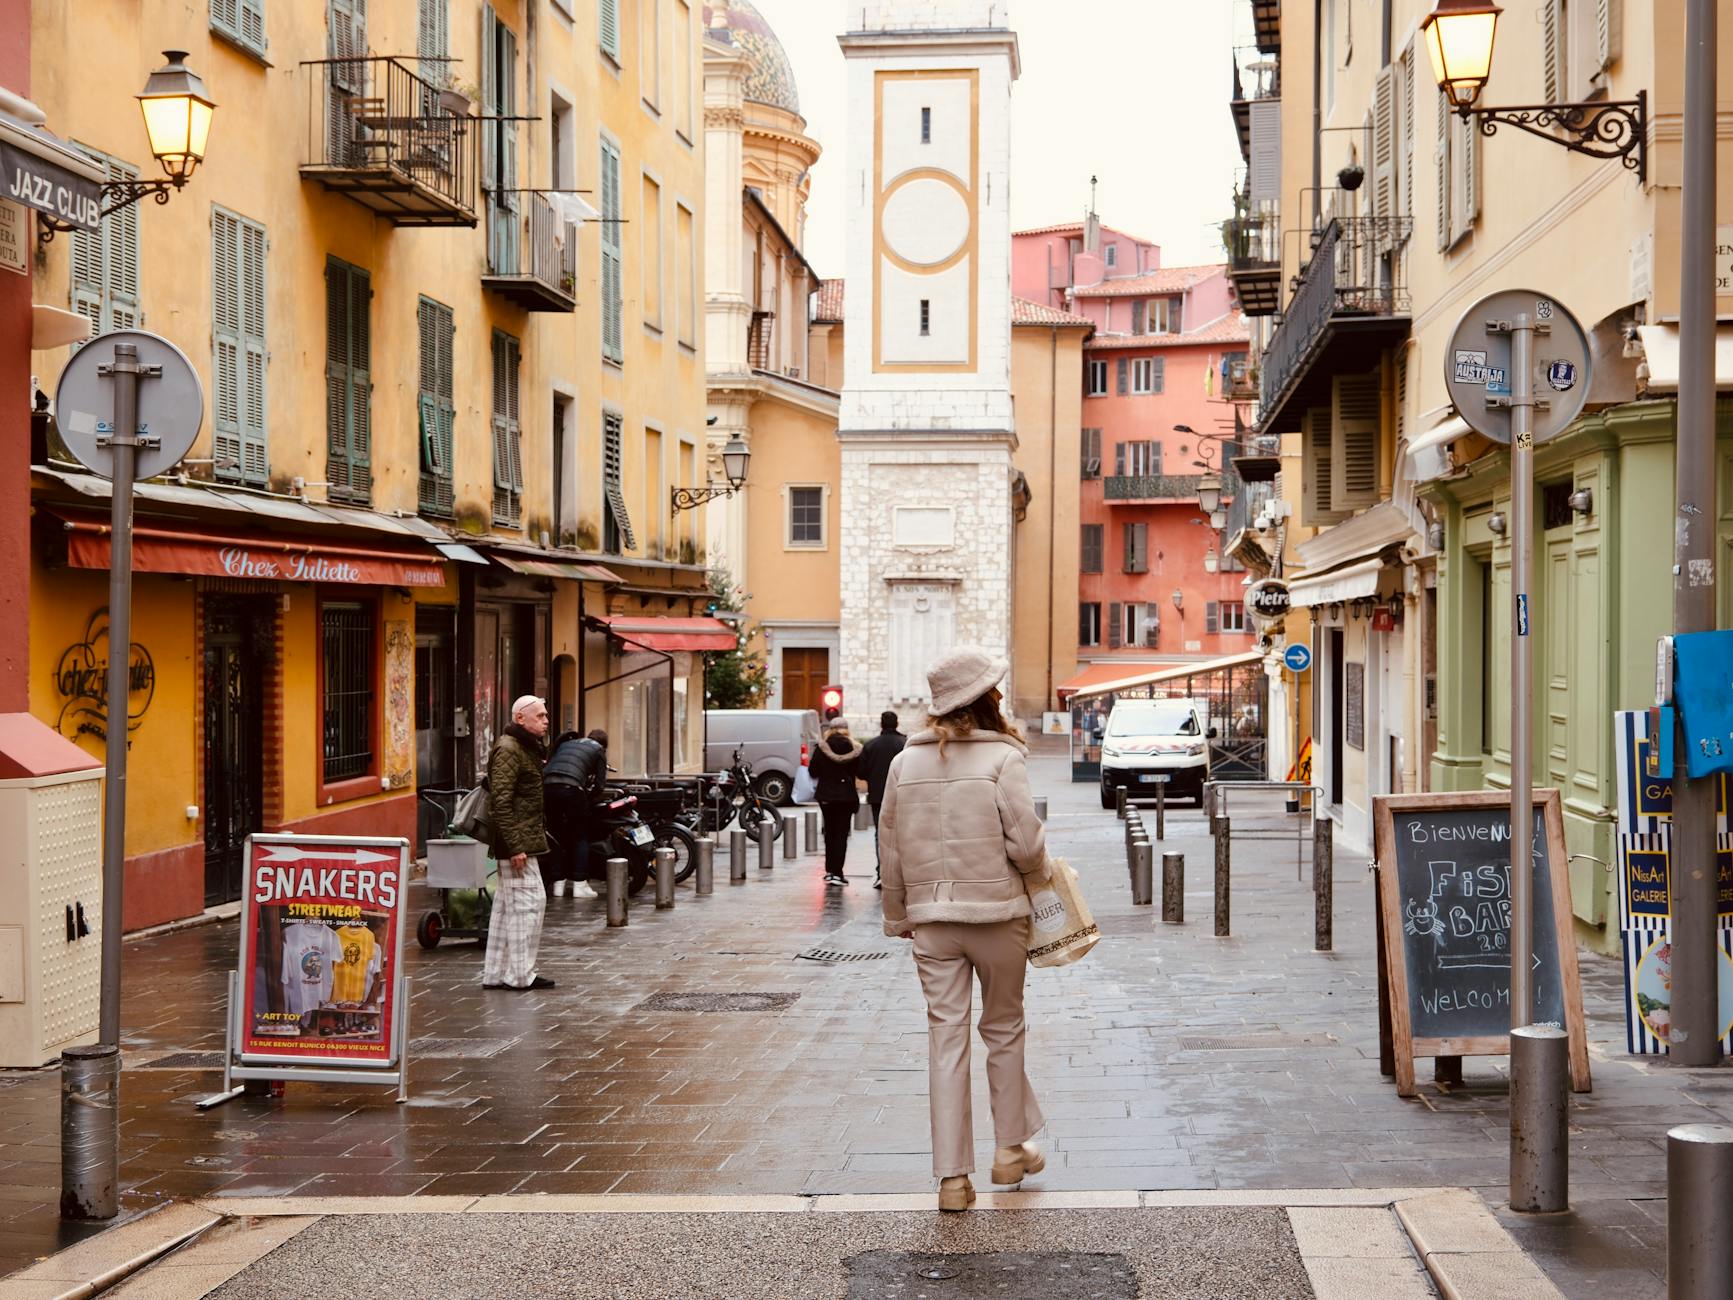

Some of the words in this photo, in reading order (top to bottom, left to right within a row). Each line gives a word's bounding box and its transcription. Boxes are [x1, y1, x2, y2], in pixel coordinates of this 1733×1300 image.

[10, 168, 54, 210] JAZZ
[57, 186, 99, 227] CLUB
[219, 547, 279, 577] Chez
[1429, 861, 1512, 898] FiS
[1631, 865, 1665, 882] NissArt
[255, 866, 397, 908] SNAKERS
[1632, 889, 1667, 903] GALERIE
[288, 903, 361, 918] STREETWEAR
[1034, 902, 1065, 923] AUER
[1477, 932, 1507, 951] 2.0
[262, 1012, 282, 1020] ART
[283, 1013, 301, 1021] TOY
